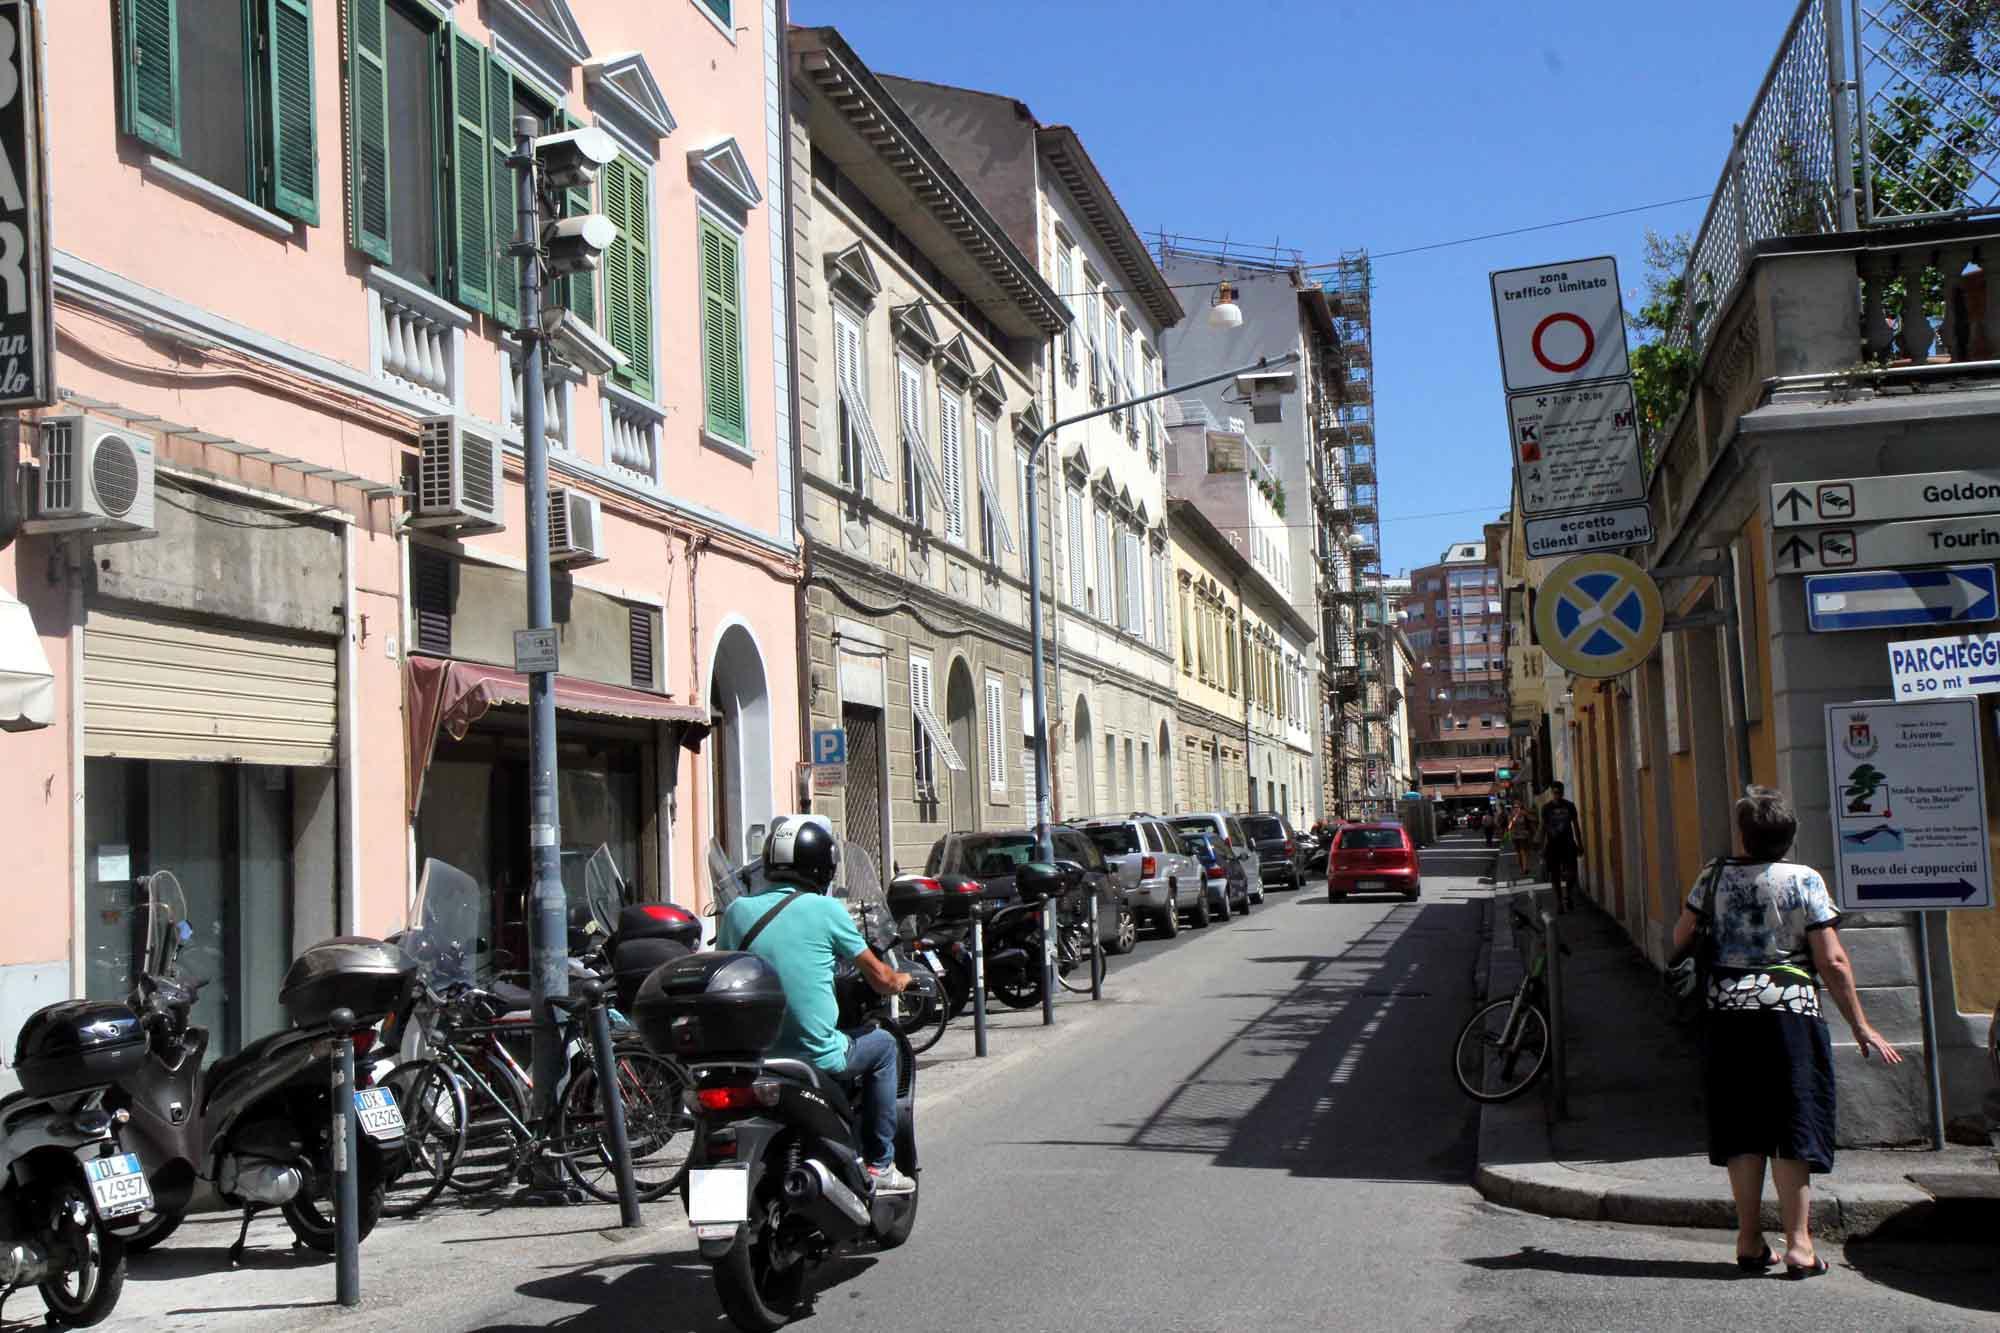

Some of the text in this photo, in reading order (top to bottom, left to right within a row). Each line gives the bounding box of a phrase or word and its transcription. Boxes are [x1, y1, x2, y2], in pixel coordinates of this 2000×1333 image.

[1539, 271, 1568, 284] zona
[1504, 277, 1607, 302] traffico limitato
[1520, 425, 1538, 442] K
[1923, 483, 2000, 503] Goldon
[1559, 516, 1615, 533] eccetto
[1532, 525, 1649, 551] clienti alberghi
[1927, 528, 2000, 549] Tourin
[1902, 676, 1962, 693] a 50 mt
[1902, 729, 1943, 740] Livorno
[821, 735, 837, 760] P
[1851, 861, 1978, 876] Bosco dei cappuccini
[365, 1109, 401, 1129] 12326
[98, 1159, 121, 1178] DL
[97, 1176, 142, 1203] 14937
